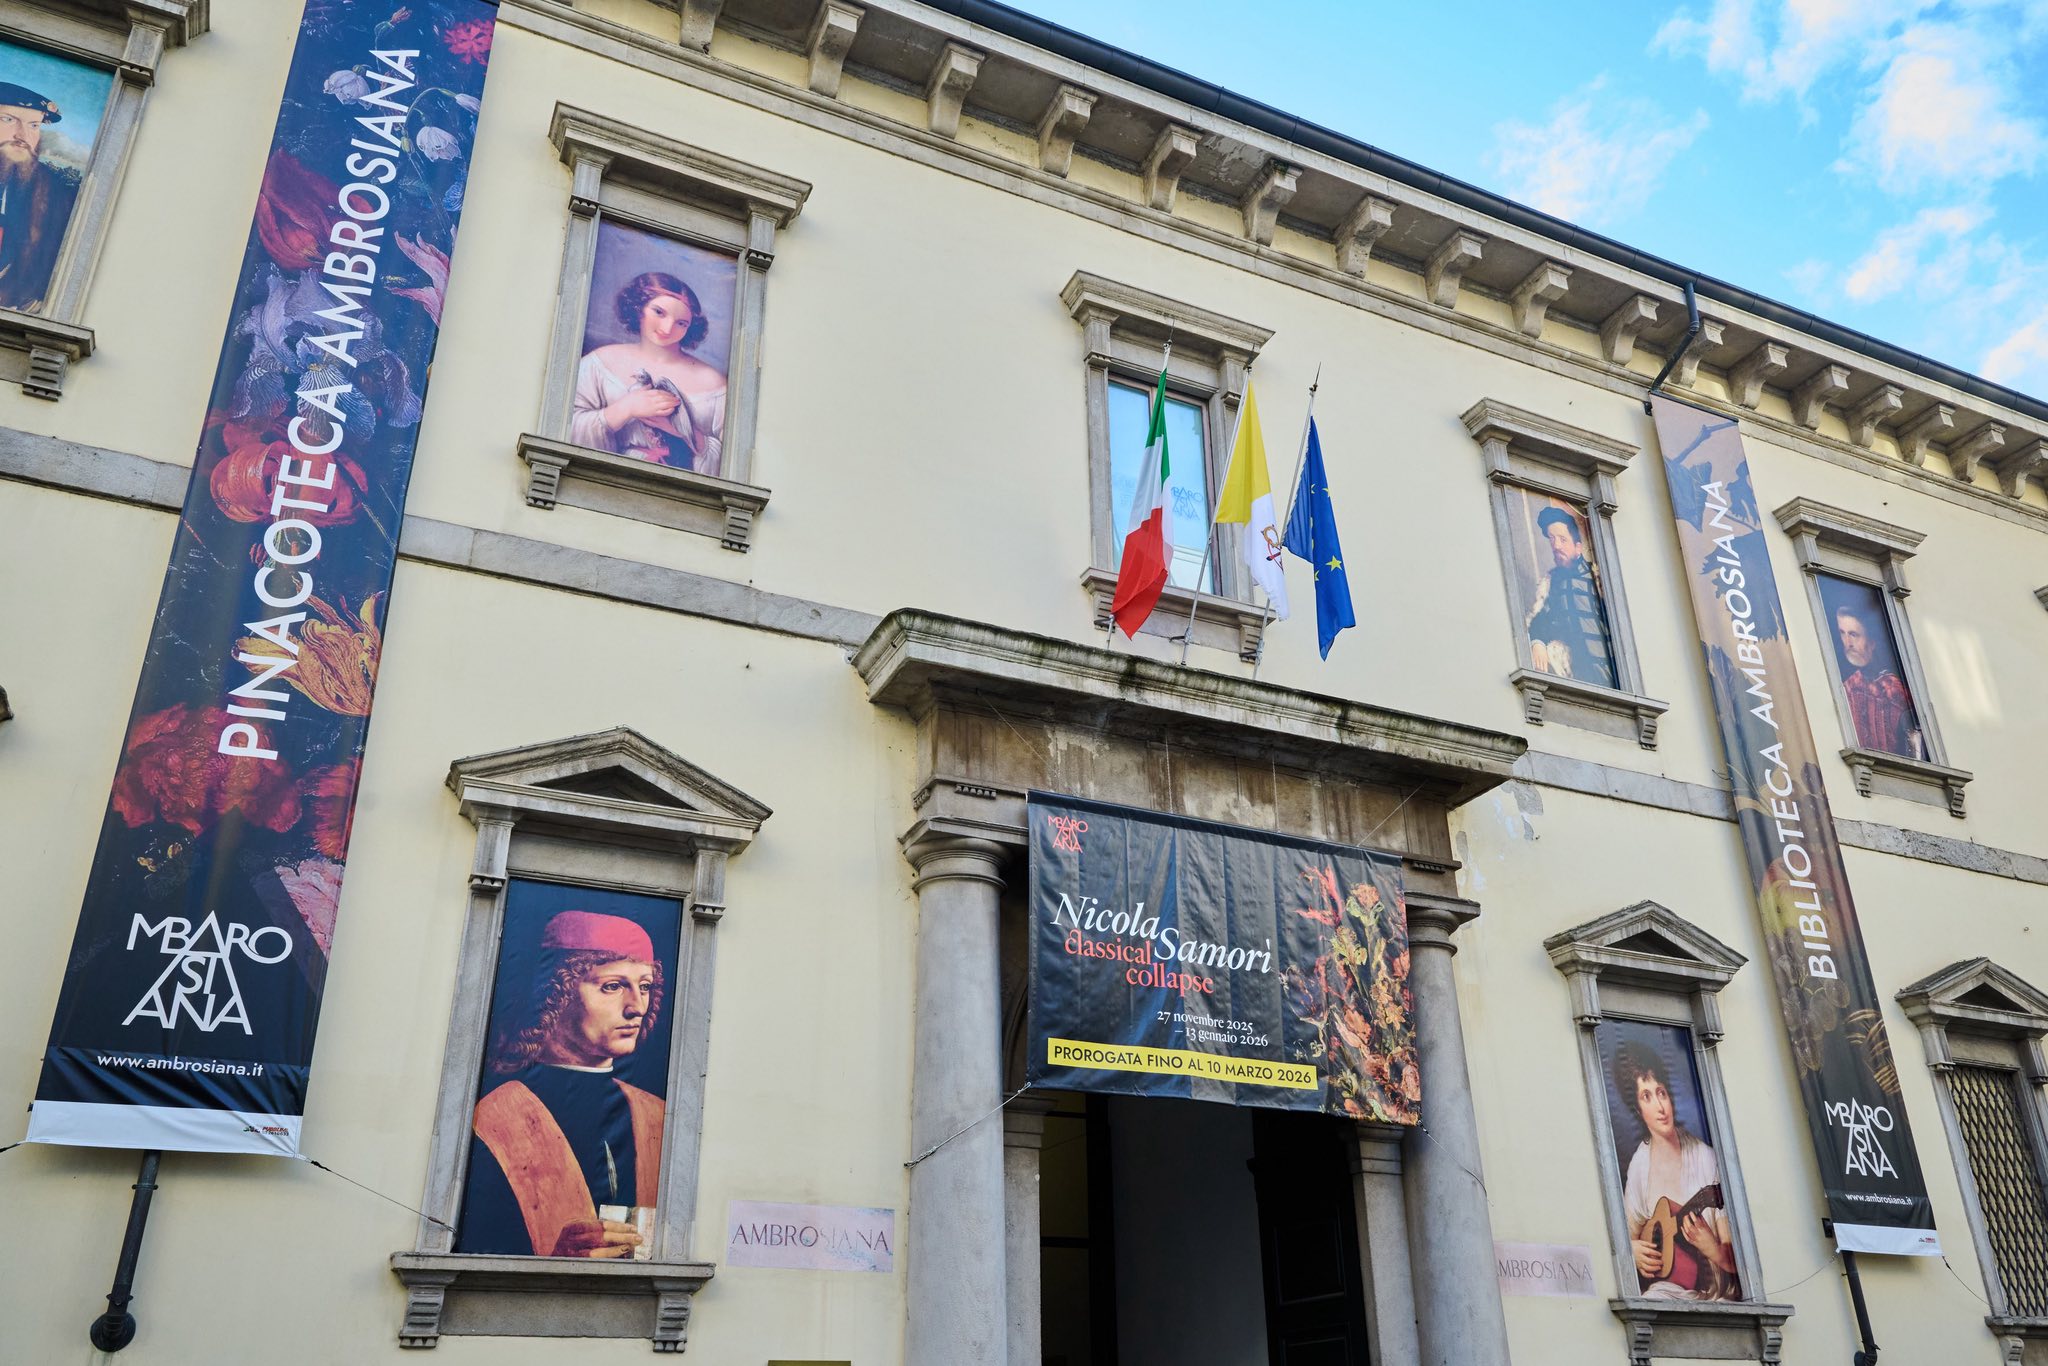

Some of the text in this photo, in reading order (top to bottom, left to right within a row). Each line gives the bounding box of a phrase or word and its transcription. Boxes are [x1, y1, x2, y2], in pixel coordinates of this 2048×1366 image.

[217, 49, 420, 761] PINACOTECA AMBROSIANA
[1700, 480, 1838, 980] BIBLIOTECA AMBROSIANA
[1050, 892, 1272, 974] Nicola Samorì
[1064, 928, 1152, 965] classical
[1126, 962, 1214, 997] collapse
[1157, 1011, 1254, 1035] 27 novembre 2025
[1185, 1027, 1197, 1042] 13
[1198, 1029, 1238, 1046] gennaio
[1240, 1034, 1269, 1047] 2026
[97, 1053, 263, 1077] www.ambrosiana.it
[1054, 1045, 1312, 1084] PROROGATA FINO AL 10 MARZO 2026
[1845, 1193, 1913, 1206] www.ambrosiana.it
[732, 1223, 889, 1251] AMBROSIANA
[1496, 1259, 1593, 1281] MBROSIANA
